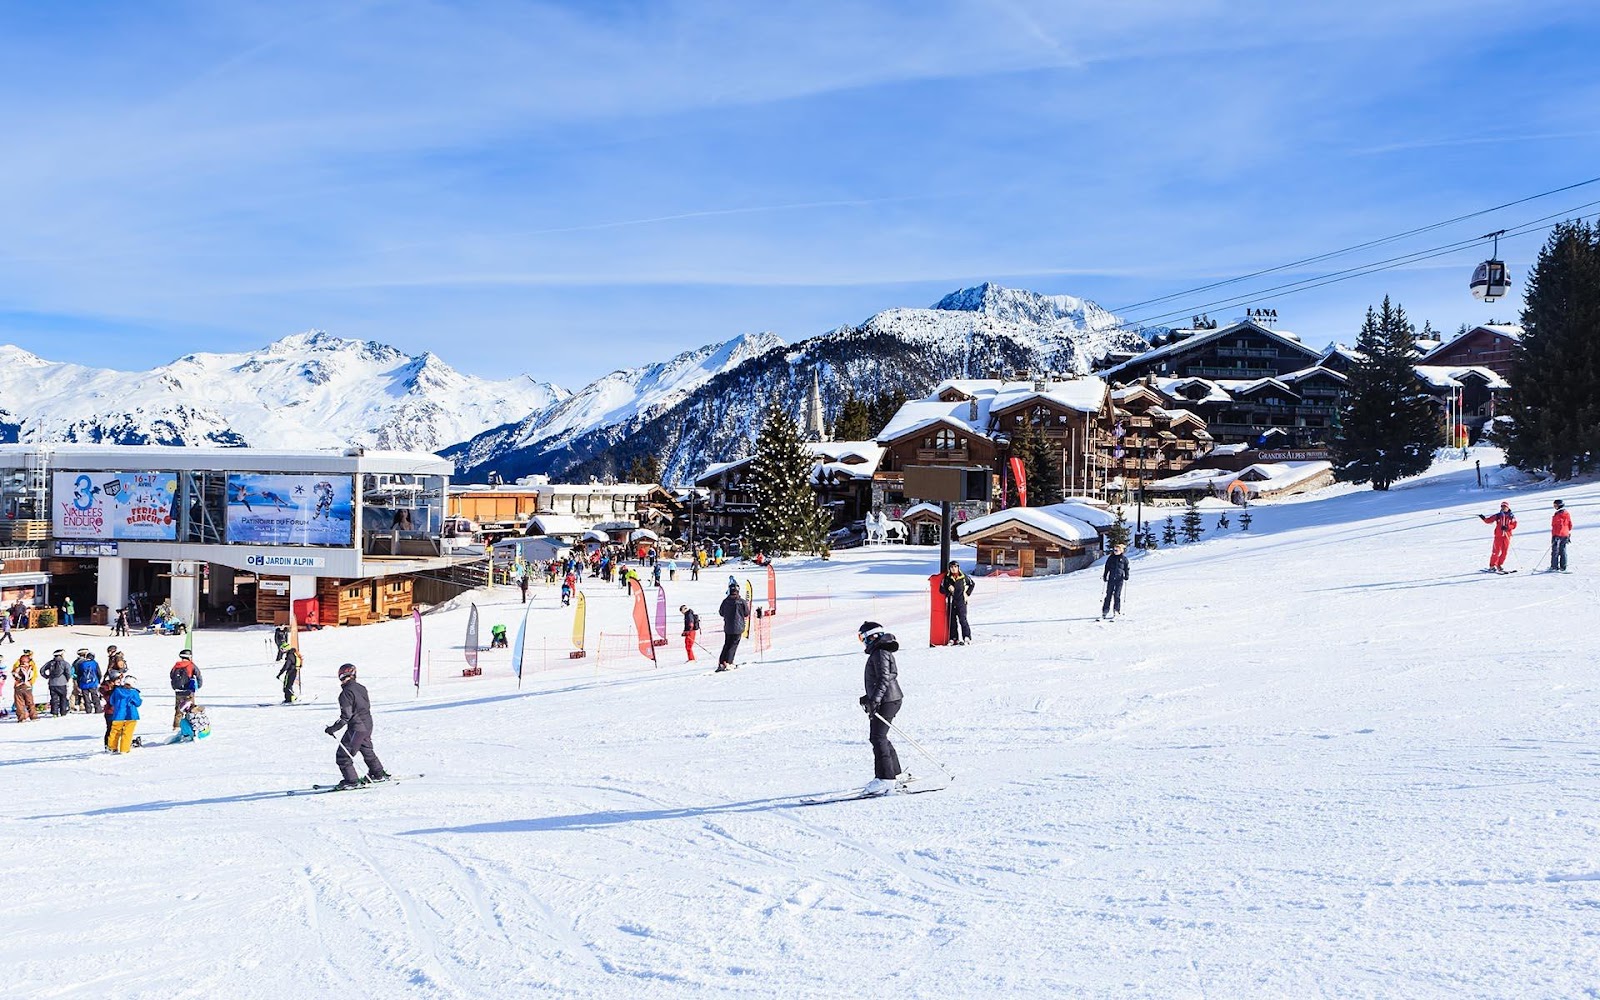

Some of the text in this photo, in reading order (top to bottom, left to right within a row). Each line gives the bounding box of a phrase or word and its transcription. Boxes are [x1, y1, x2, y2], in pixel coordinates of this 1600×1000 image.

[1246, 308, 1278, 317] LANA
[1258, 451, 1285, 460] GRANDES
[1285, 451, 1306, 460] ALPES
[134, 475, 157, 483] 16-17
[73, 474, 94, 511] 3
[241, 517, 275, 526] PATINOIRE
[285, 518, 310, 526] FORUM
[265, 557, 314, 567] JARDIN ALPIN
